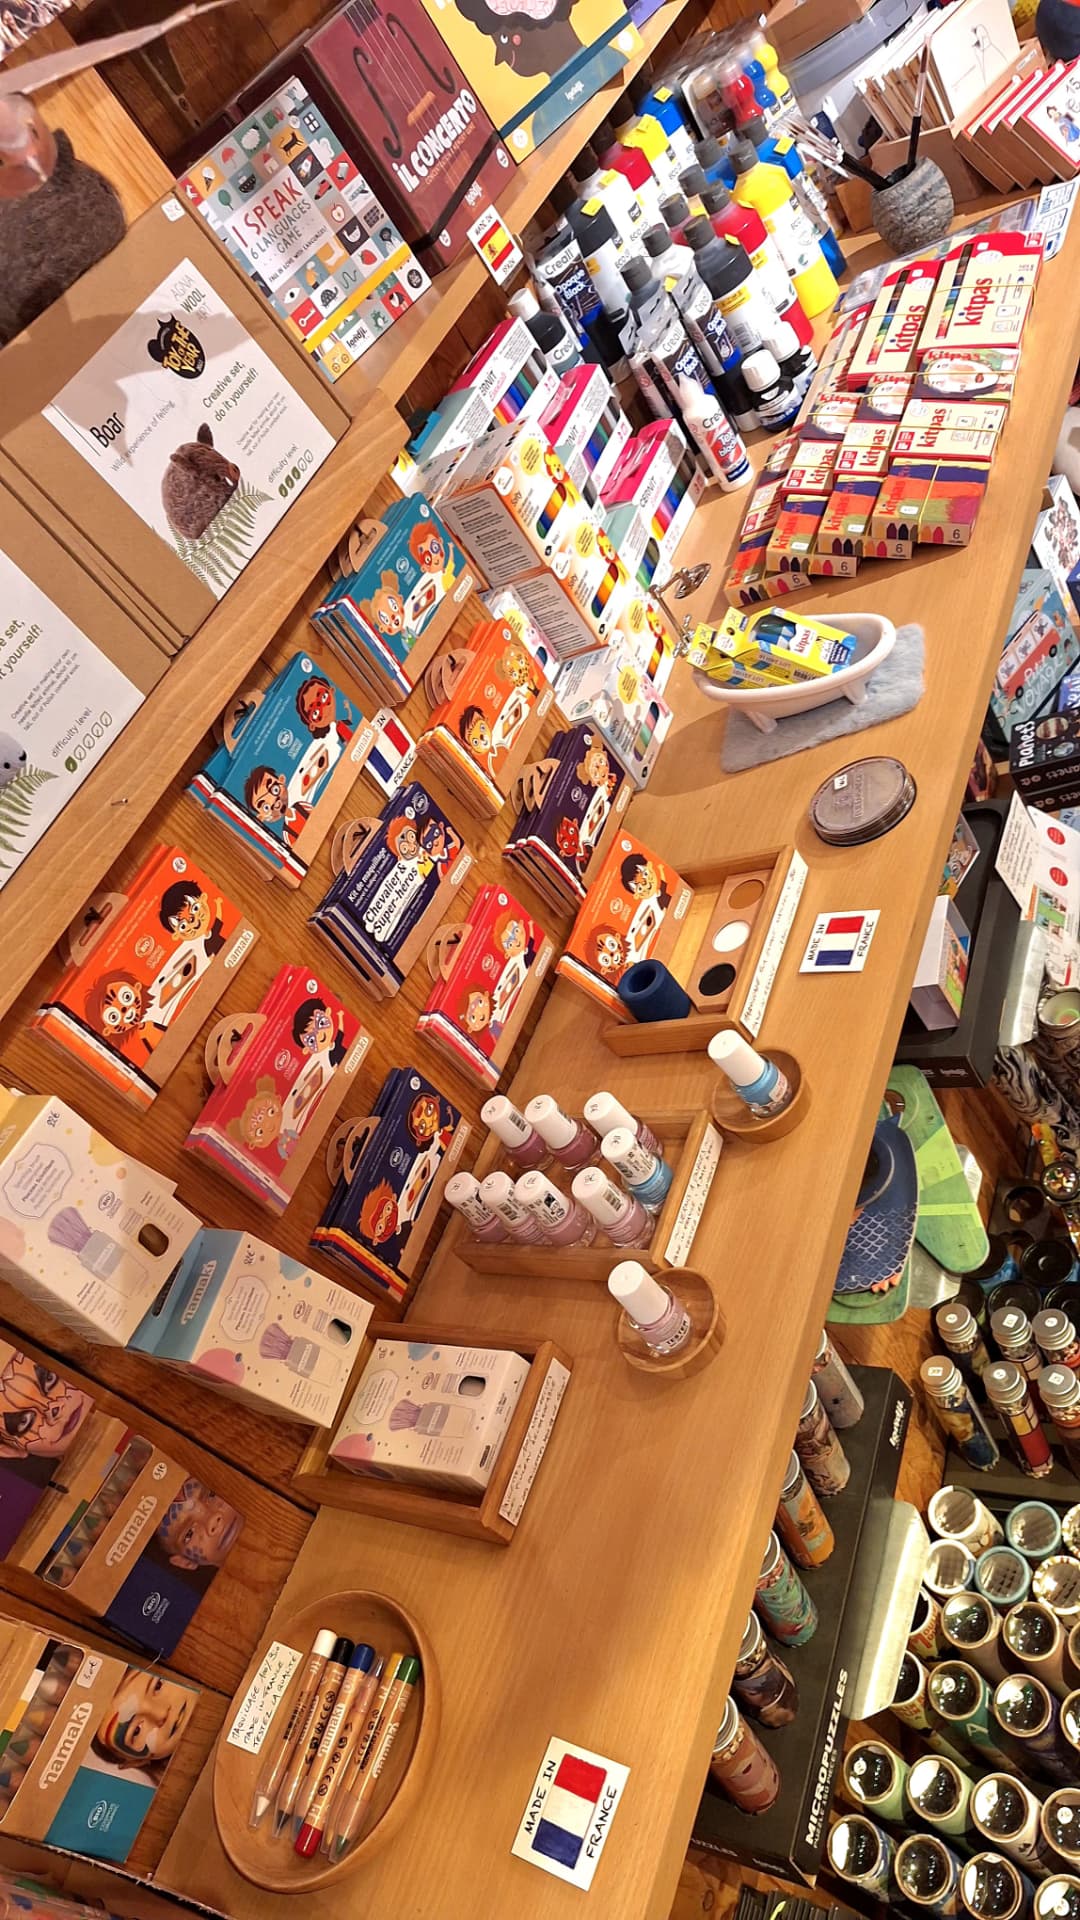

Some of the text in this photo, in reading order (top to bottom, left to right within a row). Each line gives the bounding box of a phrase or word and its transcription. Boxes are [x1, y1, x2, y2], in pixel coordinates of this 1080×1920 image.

[411, 89, 476, 177] CONCERTO
[244, 177, 302, 236] SPEAK
[250, 199, 312, 260] 6 LANGUAGES
[277, 226, 302, 254] GAME
[545, 248, 574, 275] Creall
[171, 275, 194, 300] AGNA
[180, 287, 206, 314] WOOL
[554, 268, 586, 295] Opaque
[563, 281, 587, 300] Black
[954, 277, 995, 327] kitpas
[162, 346, 181, 372] TOY
[172, 322, 190, 347] THE
[663, 325, 684, 353] Creall
[885, 304, 928, 353] kitpas
[181, 342, 201, 373] YEAR
[928, 351, 982, 362] kitpas
[203, 360, 246, 408] Creative set,
[215, 407, 226, 422] do
[230, 367, 258, 406] yourself!
[90, 412, 125, 448] Boar
[112, 399, 176, 472] Wild experience of felting
[859, 427, 887, 467] kitpas
[917, 407, 948, 448] kitpas
[268, 444, 299, 484] difficulty level
[806, 448, 836, 484] kitpas
[639, 475, 658, 508] CERNIT
[879, 480, 907, 516] kitpas
[824, 495, 849, 531] kitpas
[772, 516, 800, 550] kitpas
[895, 543, 902, 554] 6
[953, 528, 961, 540] 6
[792, 574, 800, 584] 6
[840, 561, 849, 572] 6
[5, 619, 26, 640] set,
[7, 624, 43, 673] yourself!
[51, 707, 93, 758] difficulty level
[377, 714, 387, 728] IN
[352, 728, 373, 761] namaki
[1016, 719, 1037, 769] Planets
[393, 753, 414, 785] FRANCE
[362, 847, 388, 883] maquillage
[365, 862, 407, 924] Chevalier &
[374, 867, 418, 934] Super-héros
[224, 929, 254, 968] namaki
[807, 923, 826, 961] MADE IN
[857, 921, 875, 958] FRANCE
[345, 1037, 369, 1074] namaki
[181, 1261, 217, 1324] namaki
[666, 1320, 689, 1348] TESTER
[106, 1496, 157, 1566] namaki
[232, 1686, 260, 1740] MAQUILLAGE
[244, 1715, 260, 1744] MADE
[263, 1662, 283, 1698] FRANCE
[253, 1650, 297, 1748] TESTEZ LA QUALITÉ
[39, 1702, 93, 1789] namaki
[318, 1703, 345, 1758] namaki
[372, 1721, 400, 1778] namaki
[805, 1668, 849, 1845] MICROPUZZLES
[524, 1760, 557, 1834] MADE IN
[586, 1785, 617, 1858] FRANCE
[813, 1807, 826, 1849] PUZZLE
